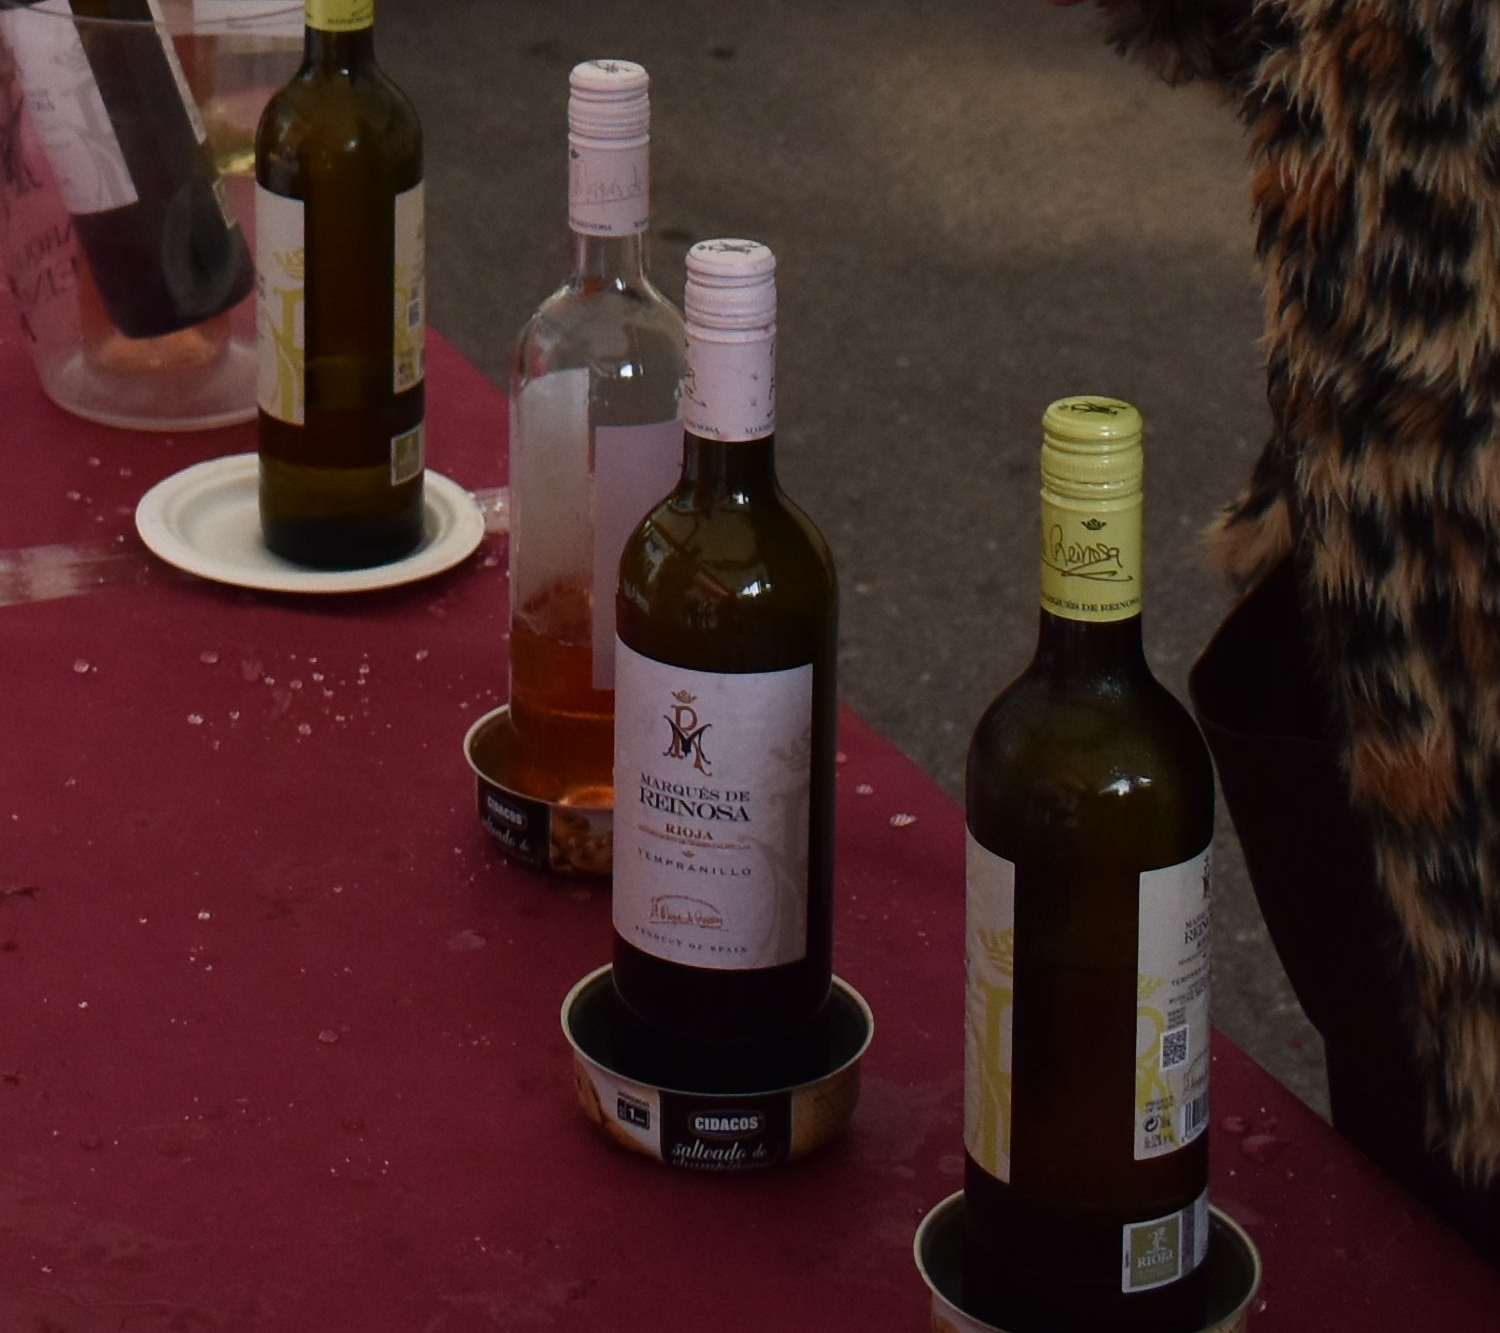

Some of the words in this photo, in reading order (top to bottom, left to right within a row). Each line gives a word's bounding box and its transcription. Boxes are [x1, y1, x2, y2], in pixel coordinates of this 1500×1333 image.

[1082, 603, 1099, 612] DE
[640, 773, 720, 801] MARQUÉS
[726, 790, 751, 802] DE
[640, 786, 751, 822] REINOSA
[665, 823, 714, 840] RIOJA
[638, 847, 752, 876] TEMPRANILLO
[694, 1116, 759, 1131] CIDACOS
[671, 1138, 747, 1160] salteado
